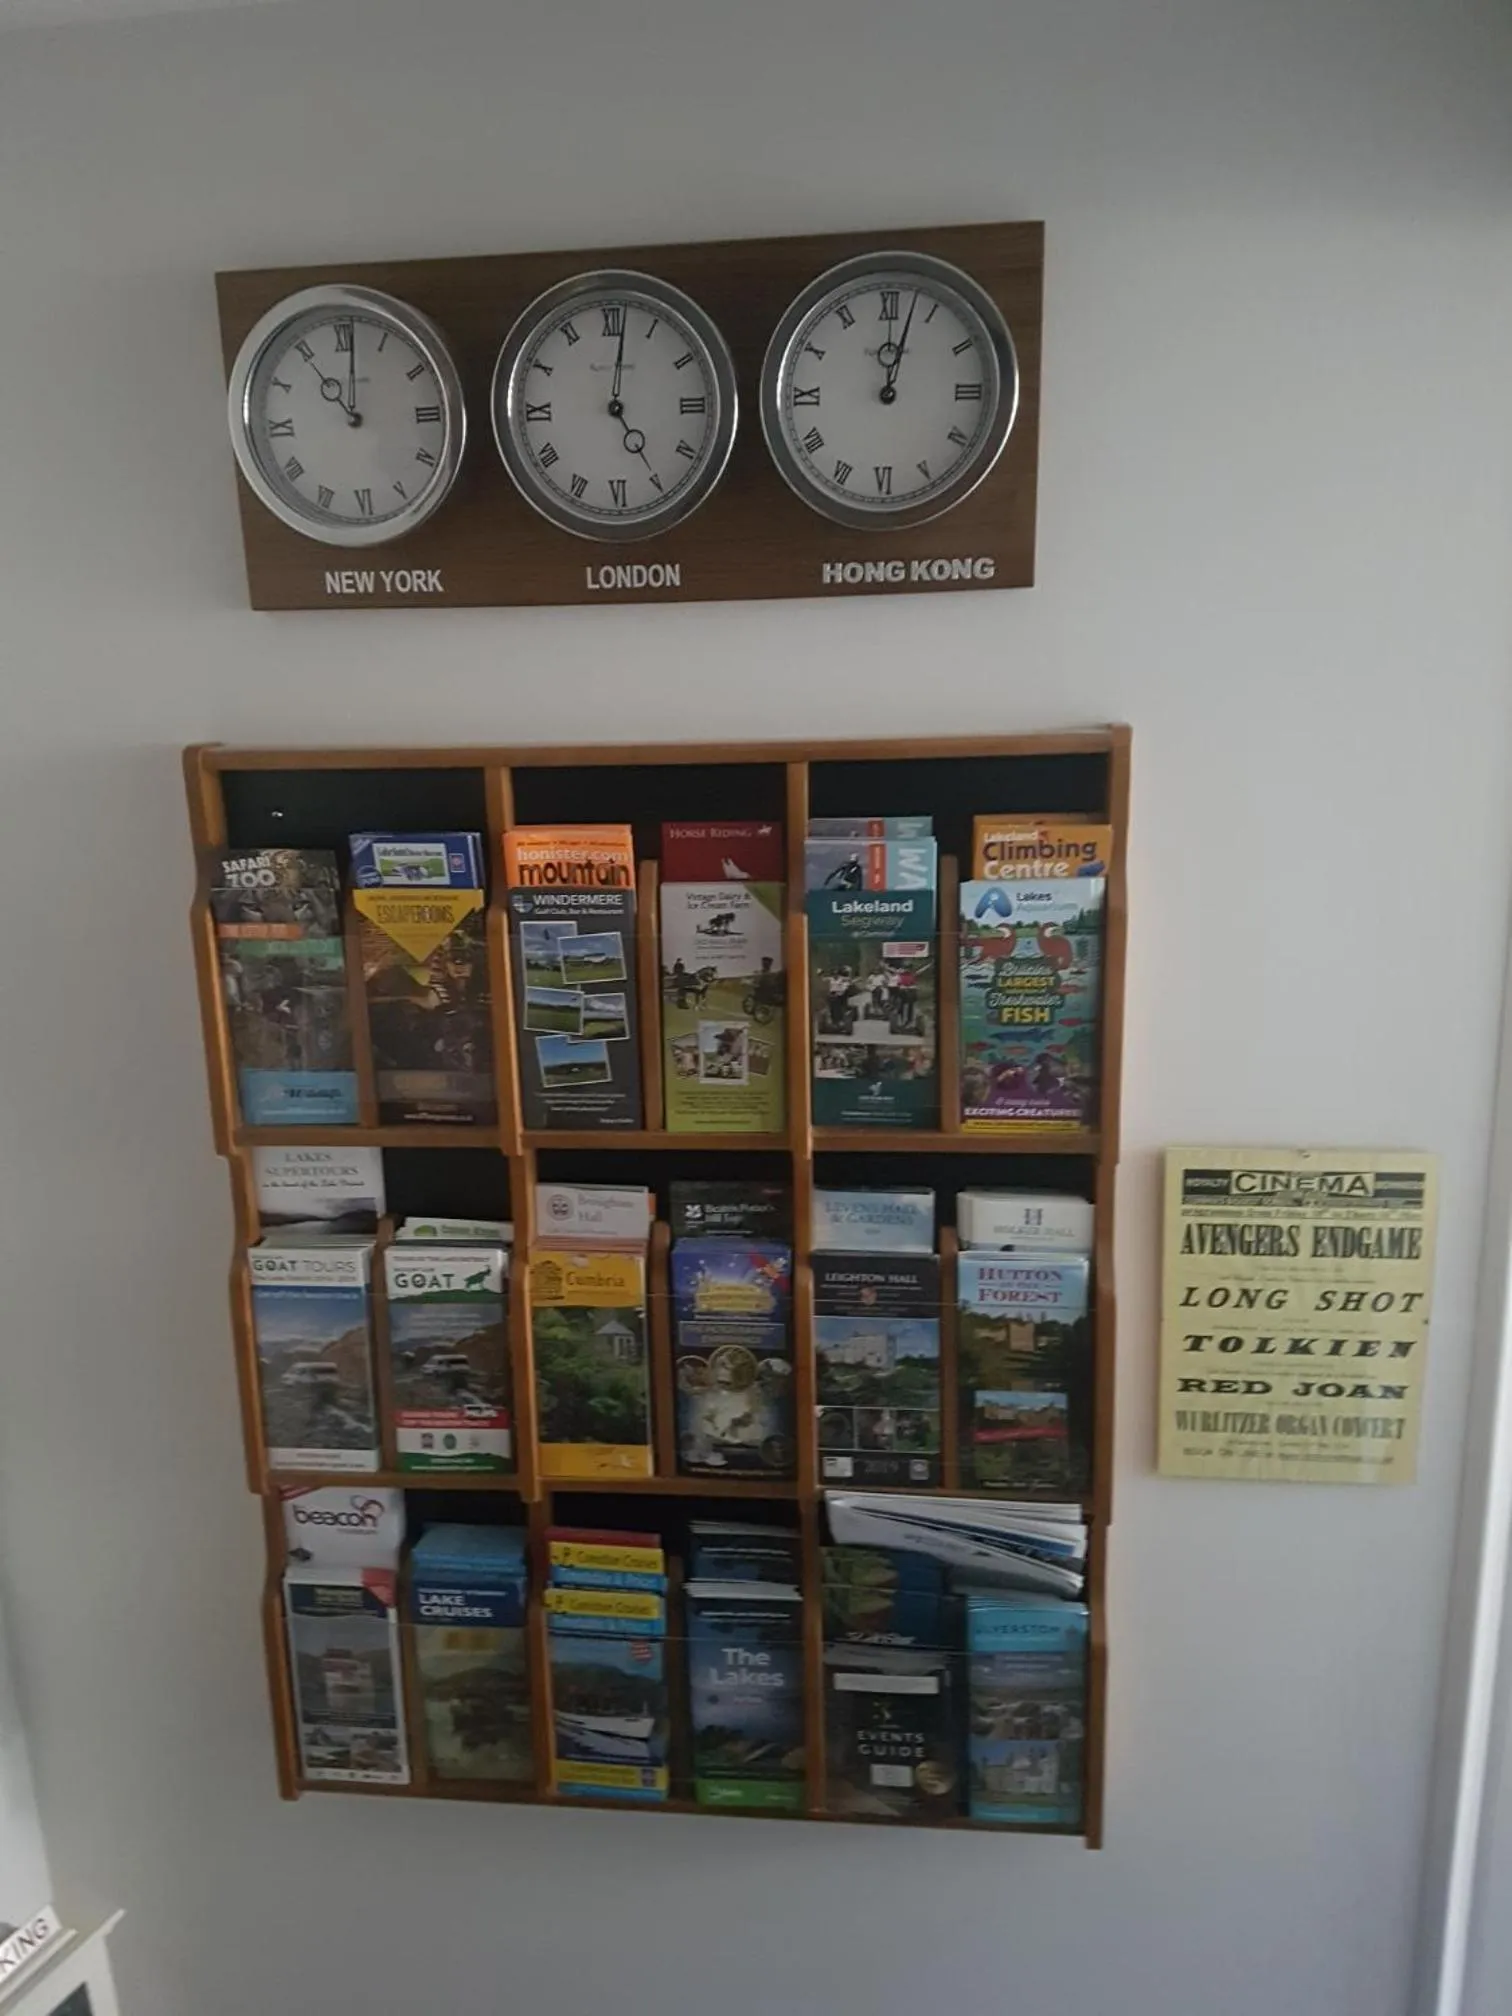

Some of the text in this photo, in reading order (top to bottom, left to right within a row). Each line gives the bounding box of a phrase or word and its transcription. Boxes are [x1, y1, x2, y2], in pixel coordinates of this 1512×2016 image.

[879, 291, 900, 321] XII
[925, 304, 939, 324] I
[602, 308, 623, 336] XII
[646, 318, 659, 339] I
[334, 324, 352, 352] XII
[378, 333, 389, 352] I
[952, 338, 974, 356] II
[804, 342, 826, 360] X
[532, 360, 553, 376] X
[673, 353, 694, 370] II
[406, 364, 424, 380] II
[272, 376, 292, 394] X
[956, 384, 982, 401] III
[794, 386, 820, 406] IX
[416, 406, 440, 424] III
[526, 402, 551, 422] IX
[680, 397, 705, 415] III
[268, 418, 295, 437] IX
[834, 460, 853, 485] VII
[916, 460, 932, 480] V
[570, 474, 588, 498] VII
[648, 474, 663, 493] V
[874, 466, 893, 495] VI
[393, 481, 408, 500] V
[608, 479, 628, 508] VI
[354, 488, 374, 516] VI
[586, 564, 681, 589] LONDON
[822, 558, 995, 584] HONG KONG
[325, 570, 443, 594] NEW YORK
[670, 826, 752, 839] HORSE RIDING
[984, 831, 1038, 843] Lakeland
[518, 846, 630, 862] honister.com
[982, 839, 1097, 863] Climbing
[222, 855, 270, 873] SAFARI
[518, 858, 632, 886] mountain
[983, 860, 1069, 880] Centre
[225, 868, 277, 888] ZOO
[533, 894, 624, 906] WINDERMERE
[1016, 892, 1052, 902] Lakes
[831, 900, 914, 914] Lakeland
[840, 914, 906, 930] Segway
[997, 976, 1055, 988] LARGEST
[1001, 1007, 1050, 1023] FISH
[284, 1152, 334, 1162] LAKES
[265, 1166, 359, 1176] SUPERTOURS
[1234, 1172, 1372, 1194] CINEMA
[579, 1211, 604, 1222] Hall
[1024, 1208, 1043, 1226] H
[1179, 1222, 1423, 1260] AVENGERS ENDGAME
[252, 1260, 356, 1273] GOAT TOURS
[978, 1267, 1064, 1282] HUTTON
[394, 1273, 454, 1289] GOAT
[825, 1273, 918, 1284] LEIGHTON HALL
[978, 1288, 1064, 1302] FOREST
[1179, 1286, 1424, 1312] LONG SHOT
[1182, 1334, 1418, 1358] TOLKIEN
[1177, 1378, 1410, 1399] RED JOAN
[1174, 1410, 1406, 1440] WURLITZER ORGAN CONCERT
[292, 1503, 378, 1528] beacon
[418, 1594, 466, 1606] LAKE
[419, 1605, 494, 1618] CRUISES
[721, 1648, 772, 1666] The
[710, 1668, 784, 1688] Lakes
[858, 1730, 925, 1744] EVENTS
[858, 1744, 925, 1758] GUIDE
